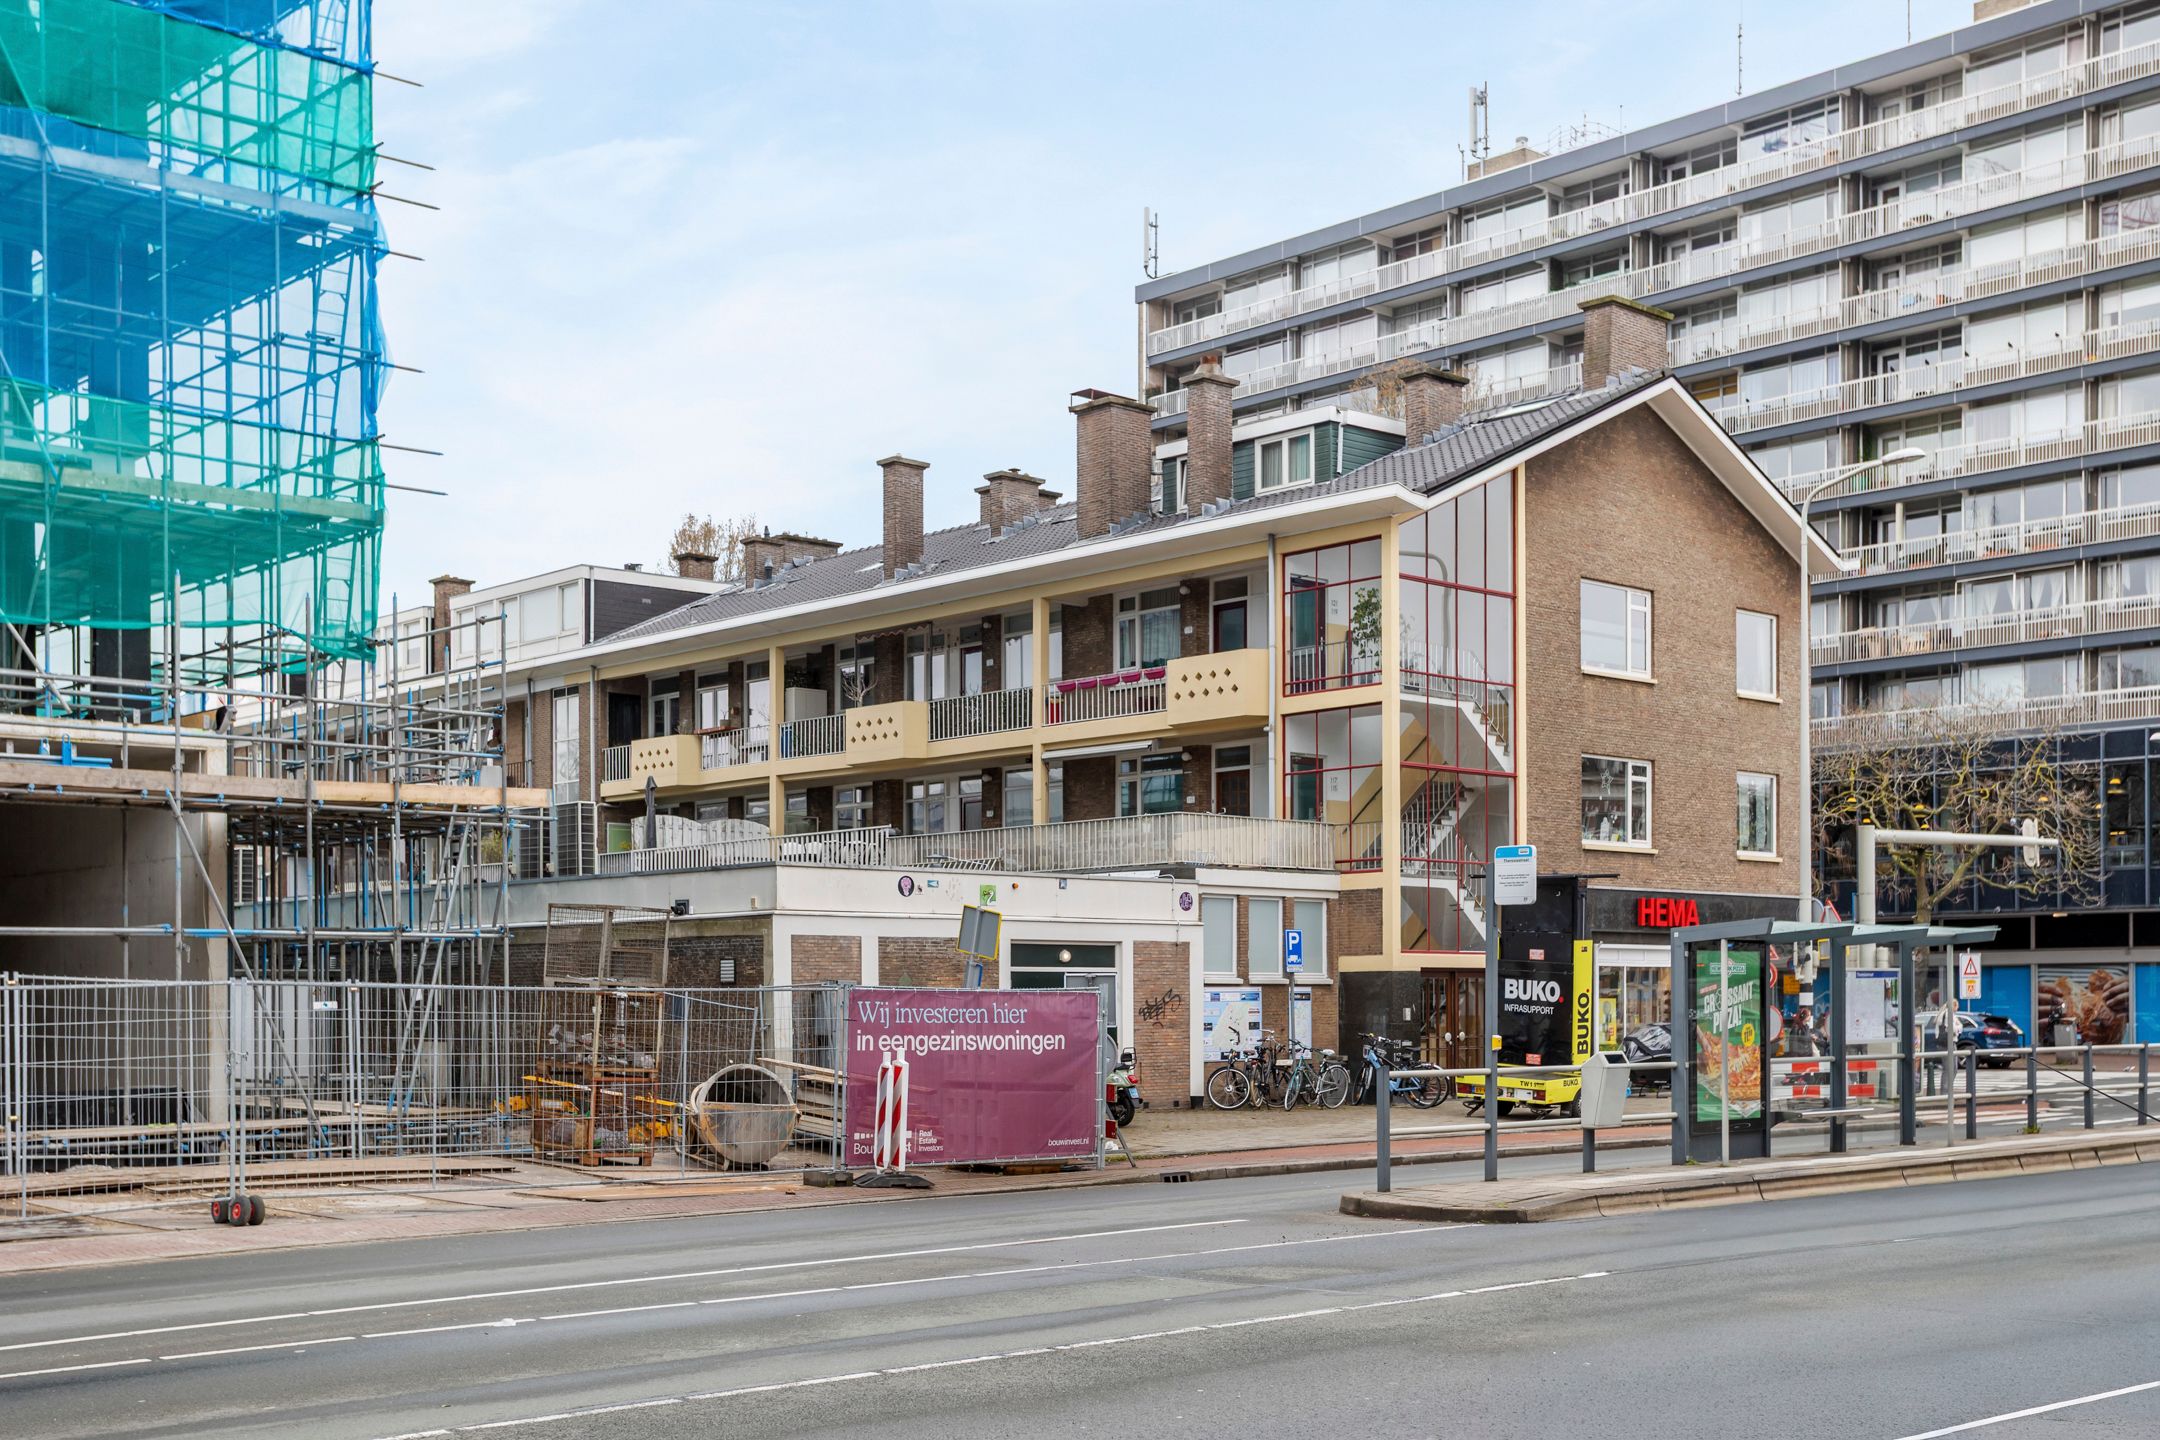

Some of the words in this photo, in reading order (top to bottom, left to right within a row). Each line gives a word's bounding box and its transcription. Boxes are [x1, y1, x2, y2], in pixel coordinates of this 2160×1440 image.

[1638, 897, 1699, 928] HEMA
[1288, 932, 1300, 950] P
[1504, 1003, 1555, 1015] INFRASUPPORT
[1704, 981, 1753, 1014] CROSSANT
[857, 1001, 889, 1028] Wij
[895, 1001, 989, 1024] investeren
[993, 1002, 1028, 1024] hier
[1713, 1004, 1742, 1034] PIZA!
[856, 1030, 874, 1051] in
[878, 1030, 1065, 1056] eengezinswoningen
[918, 1144, 944, 1152] Investors
